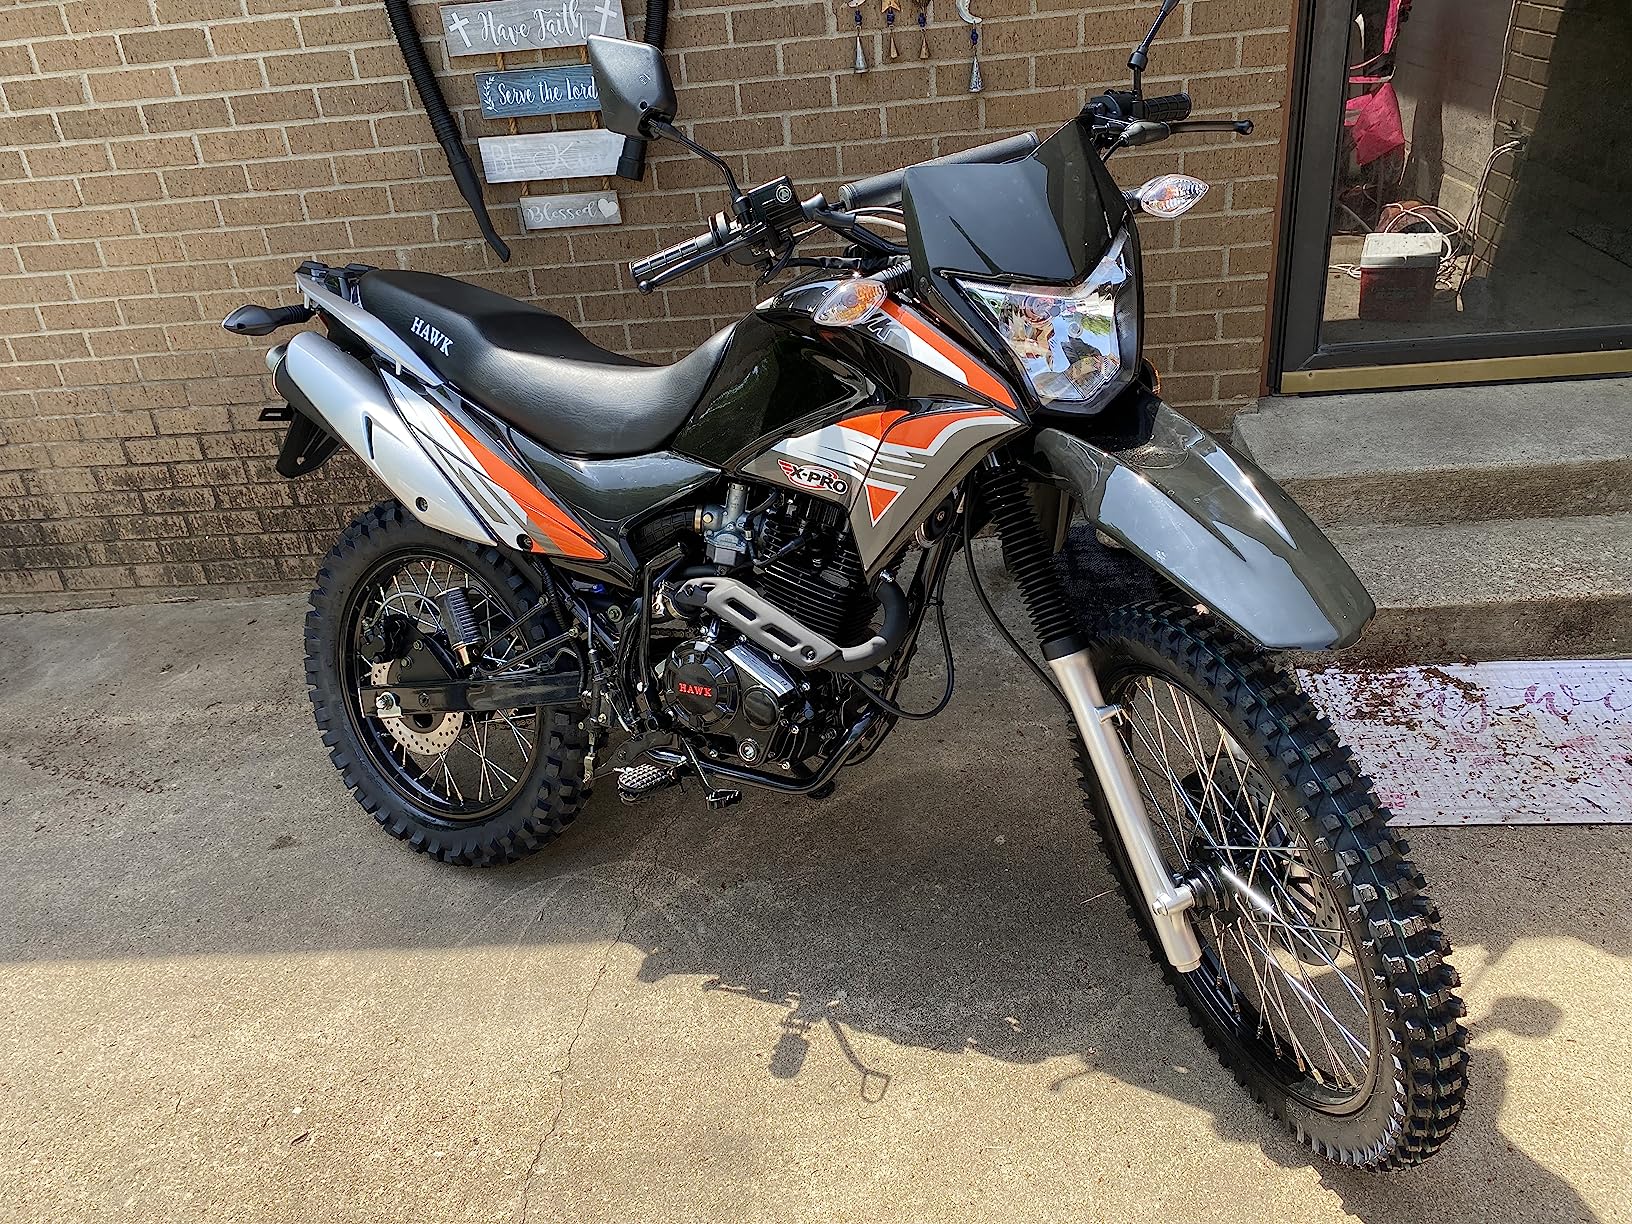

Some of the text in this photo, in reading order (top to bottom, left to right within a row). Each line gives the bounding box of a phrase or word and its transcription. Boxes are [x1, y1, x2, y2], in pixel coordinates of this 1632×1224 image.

[477, 0, 588, 46] Have Faith
[497, 75, 599, 106] Serve the Lord
[524, 200, 598, 224] Blessed
[410, 316, 454, 357] HAWK
[790, 464, 847, 494] X-PRO
[678, 682, 713, 698] HAWK
